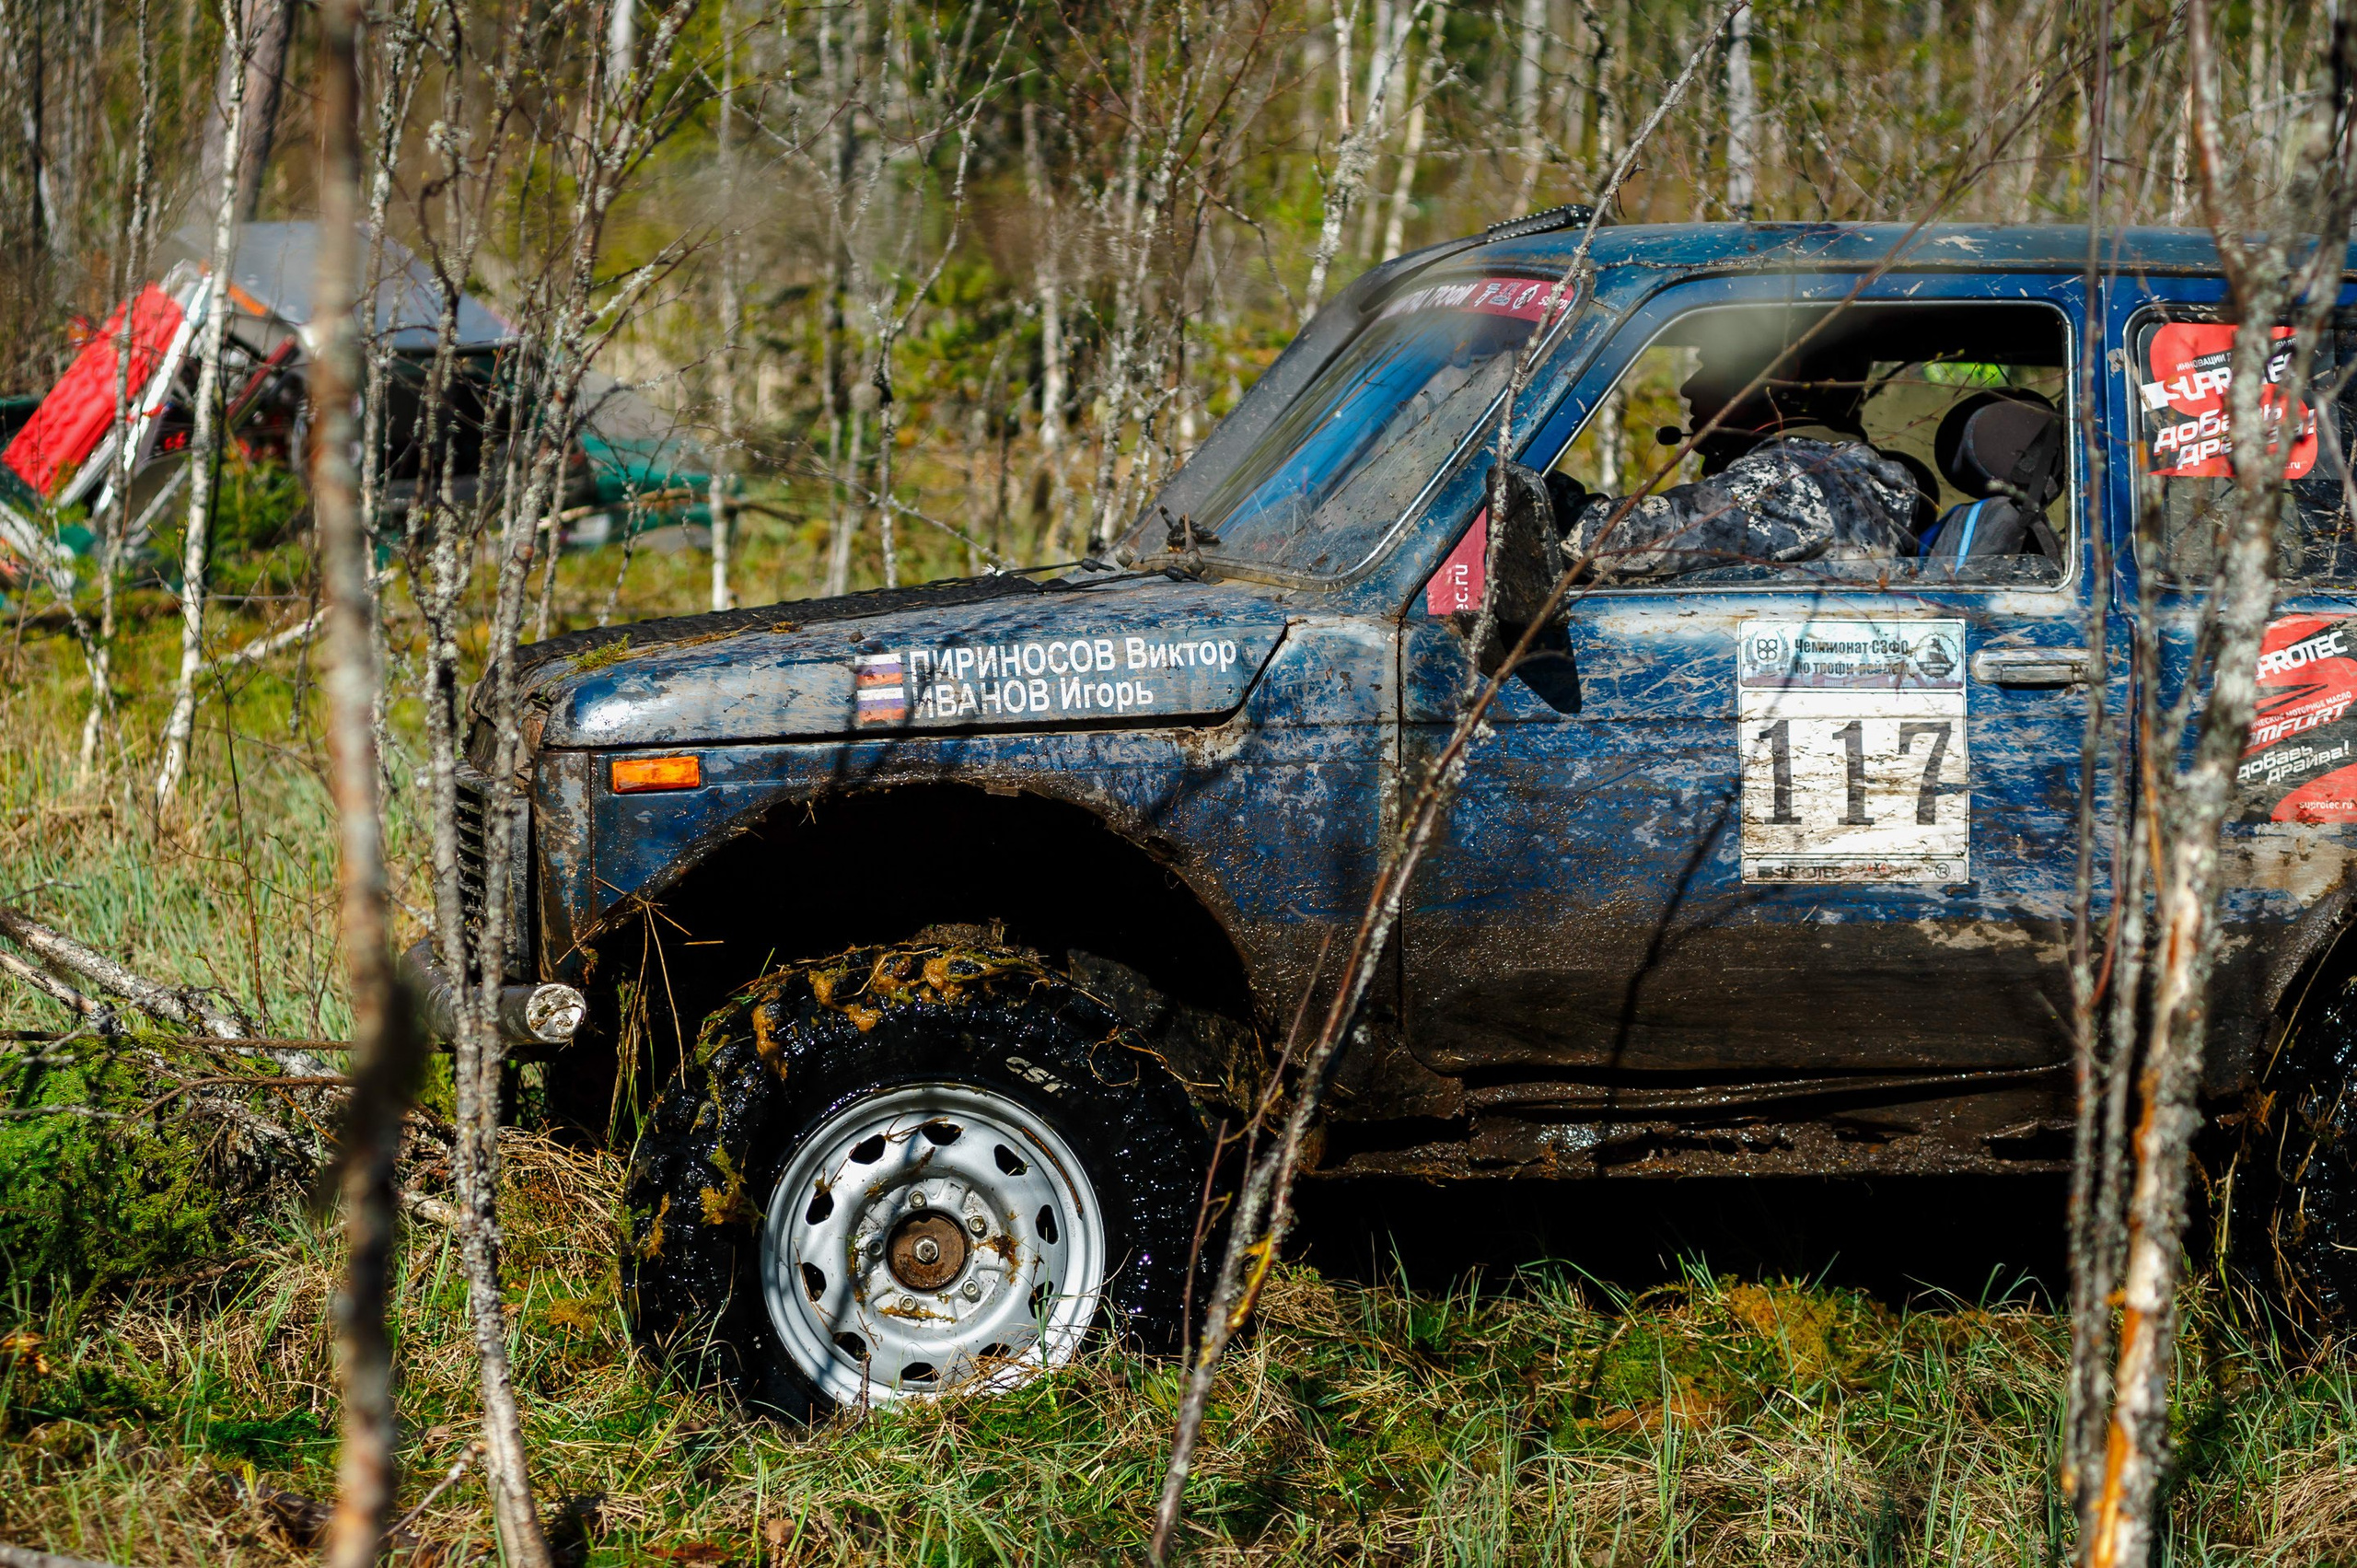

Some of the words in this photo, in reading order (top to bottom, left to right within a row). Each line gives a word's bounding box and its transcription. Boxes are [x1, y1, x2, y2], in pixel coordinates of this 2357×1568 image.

[910, 639, 1114, 683] ПИРИНОСОВ
[1125, 636, 1237, 673] Виктор
[1872, 639, 1909, 655] СЗФО
[2256, 630, 2349, 680] PROTEC
[911, 678, 1051, 719] ИВАНОВ
[1060, 676, 1155, 714] Игорь
[2251, 713, 2284, 729] ИЧЕСКОЕ
[2285, 700, 2325, 718] МОТОРНОЕ
[2326, 691, 2352, 705] МАСЛО
[2245, 701, 2350, 749] OMFORT
[1758, 719, 1952, 826] 117
